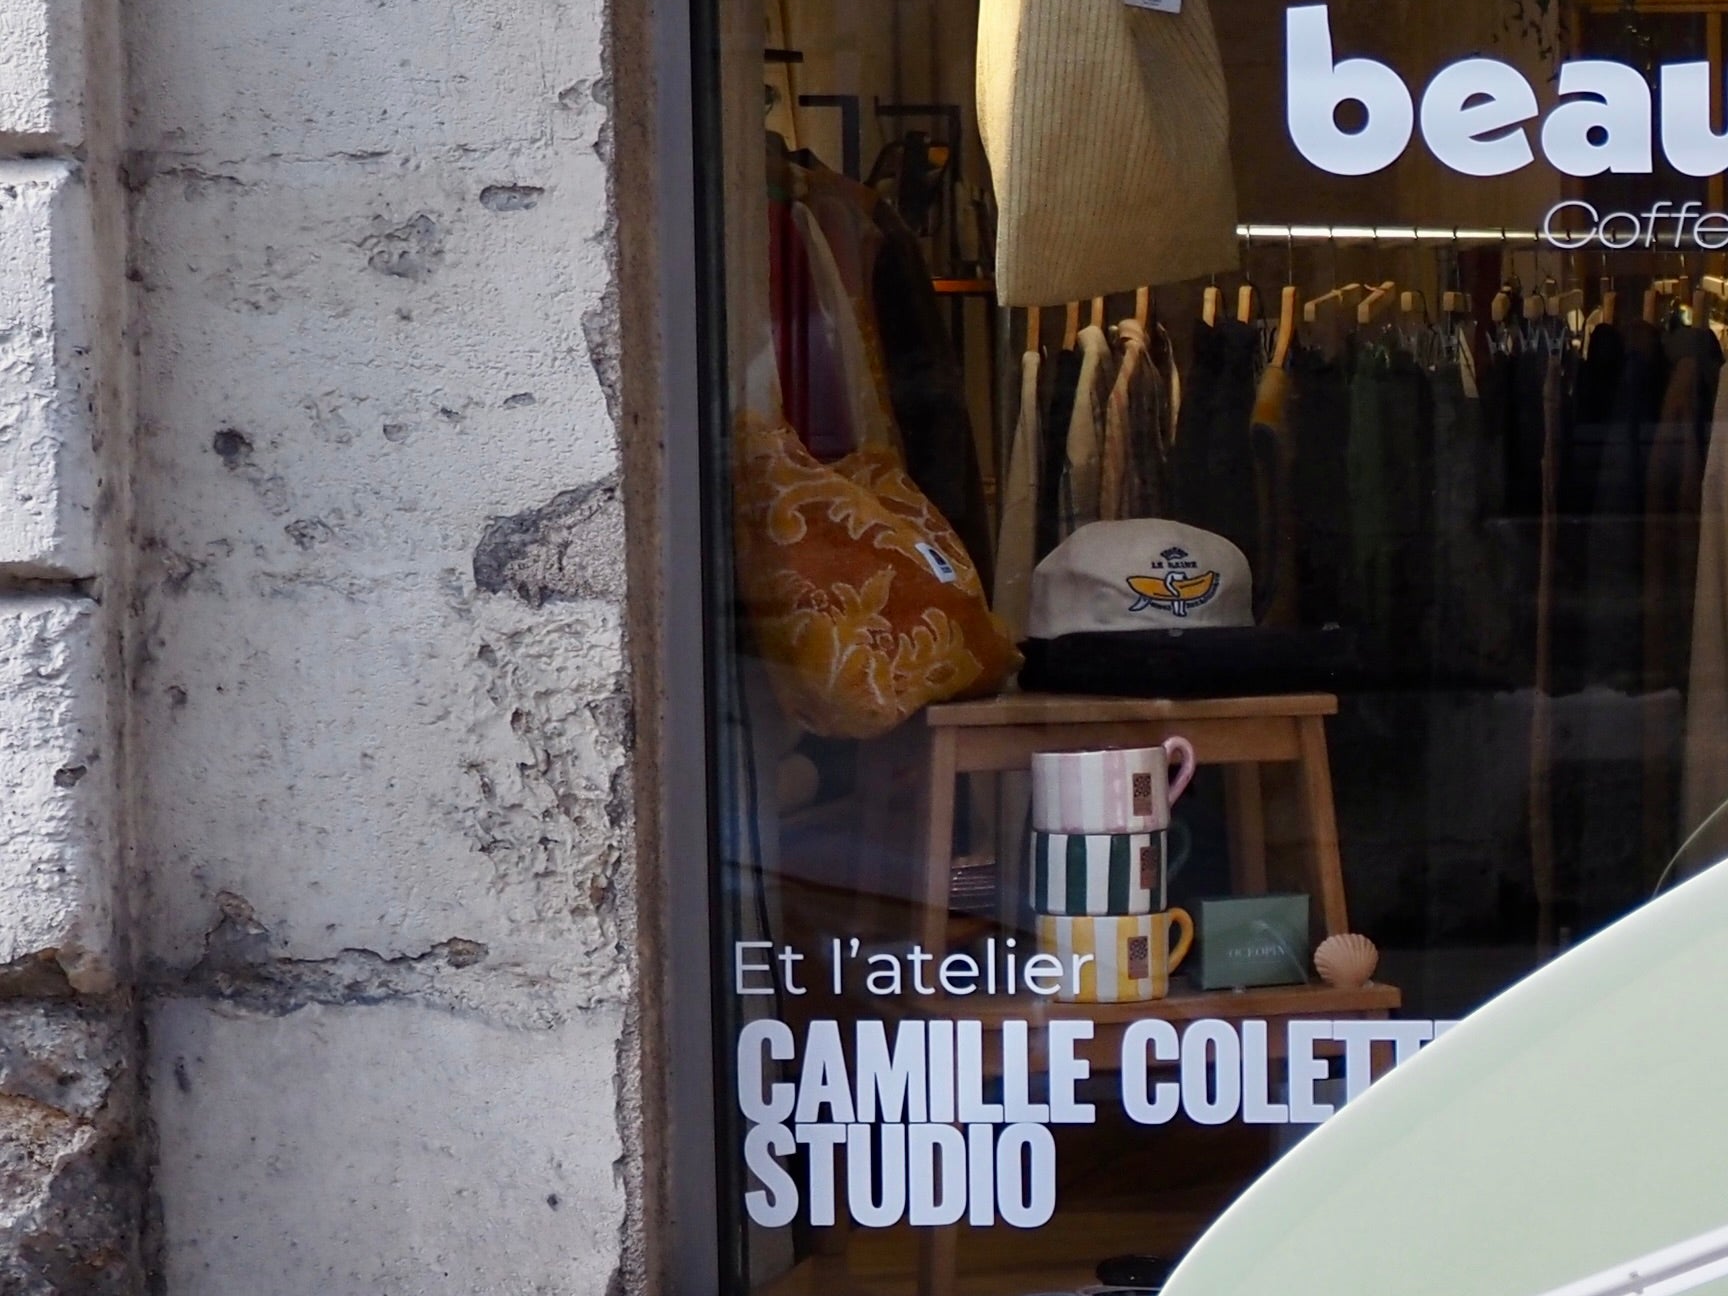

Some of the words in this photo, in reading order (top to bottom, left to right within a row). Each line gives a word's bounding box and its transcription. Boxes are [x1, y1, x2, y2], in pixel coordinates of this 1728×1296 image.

[734, 940, 807, 996] Et
[737, 1018, 1096, 1125] CAMILLE
[1120, 1018, 1462, 1125] COLETT
[744, 1122, 1057, 1228] STUDIO
